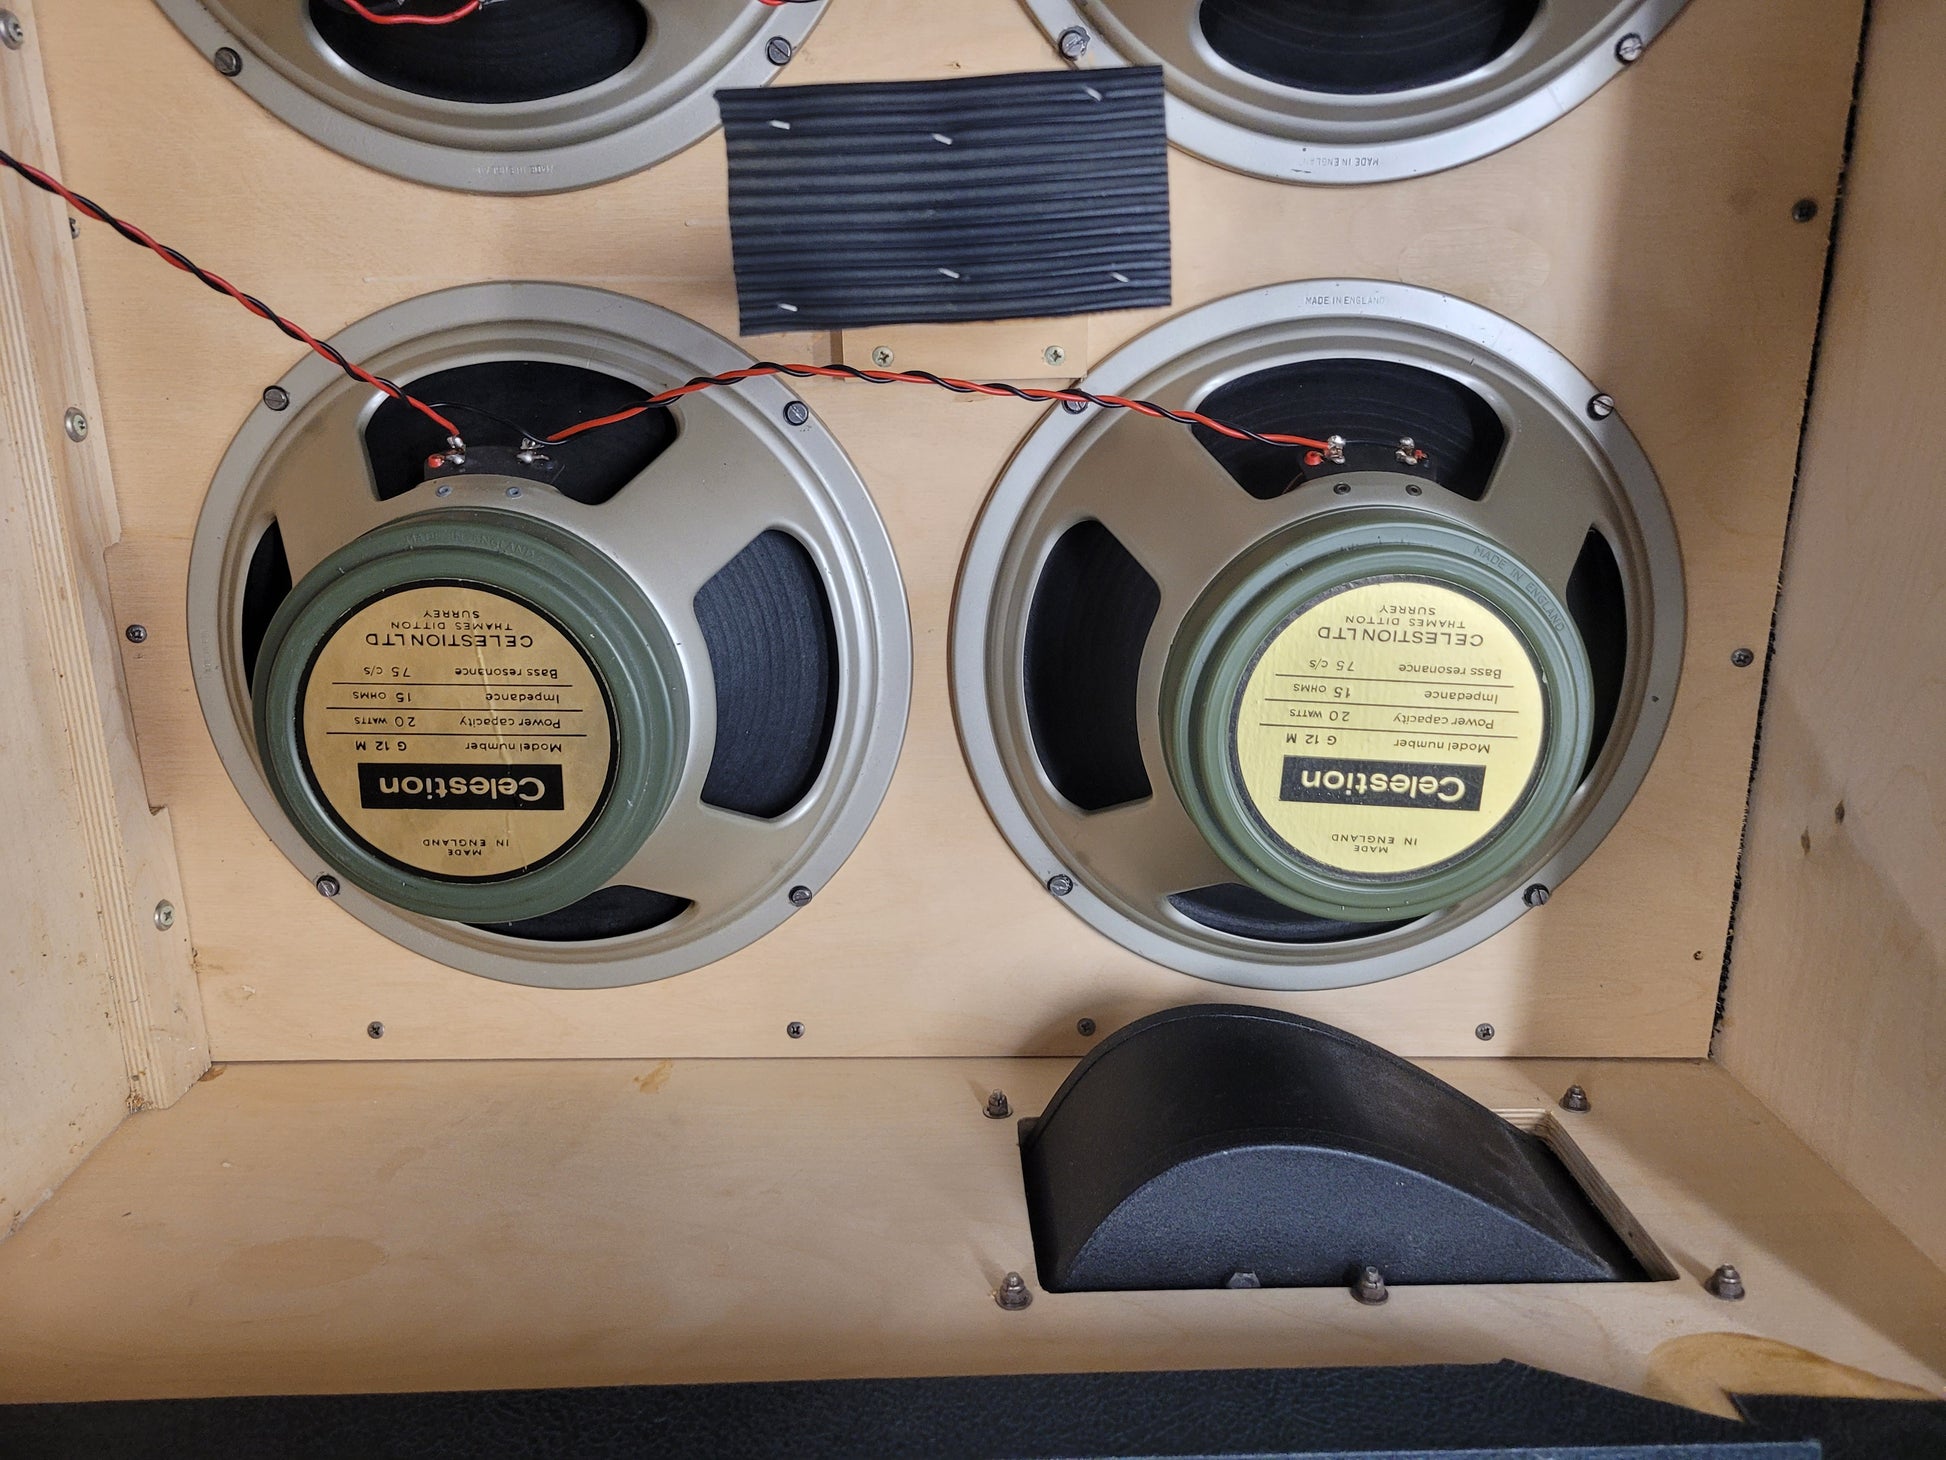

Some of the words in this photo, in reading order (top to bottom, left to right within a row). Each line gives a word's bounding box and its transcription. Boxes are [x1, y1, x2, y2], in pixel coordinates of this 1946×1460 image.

[1301, 157, 1340, 167] ENGLA
[1342, 157, 1352, 166] IN
[1355, 156, 1380, 167] MADE
[1305, 295, 1329, 305] MADE
[1332, 295, 1342, 304] IN
[1343, 295, 1385, 305] ENGLAND
[1473, 545, 1508, 569] MADE
[1509, 567, 1525, 583] IN
[1525, 583, 1565, 632] ENGLAND
[423, 610, 479, 619] SURREY
[1379, 605, 1436, 615] SURREY
[1345, 616, 1399, 625] DITTON
[1409, 619, 1465, 628] THAMES
[391, 622, 445, 630] DITTON
[455, 622, 513, 630] THAMES
[1317, 627, 1357, 640] LTD
[1360, 629, 1484, 647] CELESTION
[365, 633, 404, 646] LTD
[408, 634, 533, 648] CELESTION
[1309, 659, 1328, 669] c/s
[1336, 661, 1354, 671] 75
[364, 666, 383, 676] c/s
[391, 667, 410, 677] 75
[455, 667, 522, 677] resonance
[527, 668, 557, 678] Bass
[1399, 664, 1466, 676] resonance
[1470, 668, 1502, 679] Bass
[1293, 684, 1326, 693] OHMS
[1334, 687, 1351, 697] 15
[352, 691, 386, 699] OHMS
[396, 692, 412, 702] 15
[486, 691, 559, 703] Impedance
[1424, 690, 1498, 704] Impedance
[1290, 709, 1323, 718] WATTS
[1329, 711, 1350, 721] 20
[394, 716, 416, 726] 20
[460, 715, 514, 727] capacity
[519, 718, 560, 728] Power
[1393, 713, 1448, 726] capacity
[1451, 718, 1494, 729] Power
[1286, 733, 1297, 743] M
[1306, 735, 1319, 744] 12
[1327, 736, 1336, 745] G
[355, 741, 366, 750] M
[376, 741, 389, 751] 12
[397, 741, 406, 751] G
[465, 742, 515, 751] number
[520, 743, 561, 752] Model
[1394, 739, 1444, 750] number
[1448, 742, 1490, 753] Model
[379, 776, 545, 801] Celestion
[1301, 770, 1465, 802] Celestion
[1331, 834, 1394, 844] ENGLAND
[1404, 837, 1417, 845] IN
[1354, 845, 1388, 853] MADE
